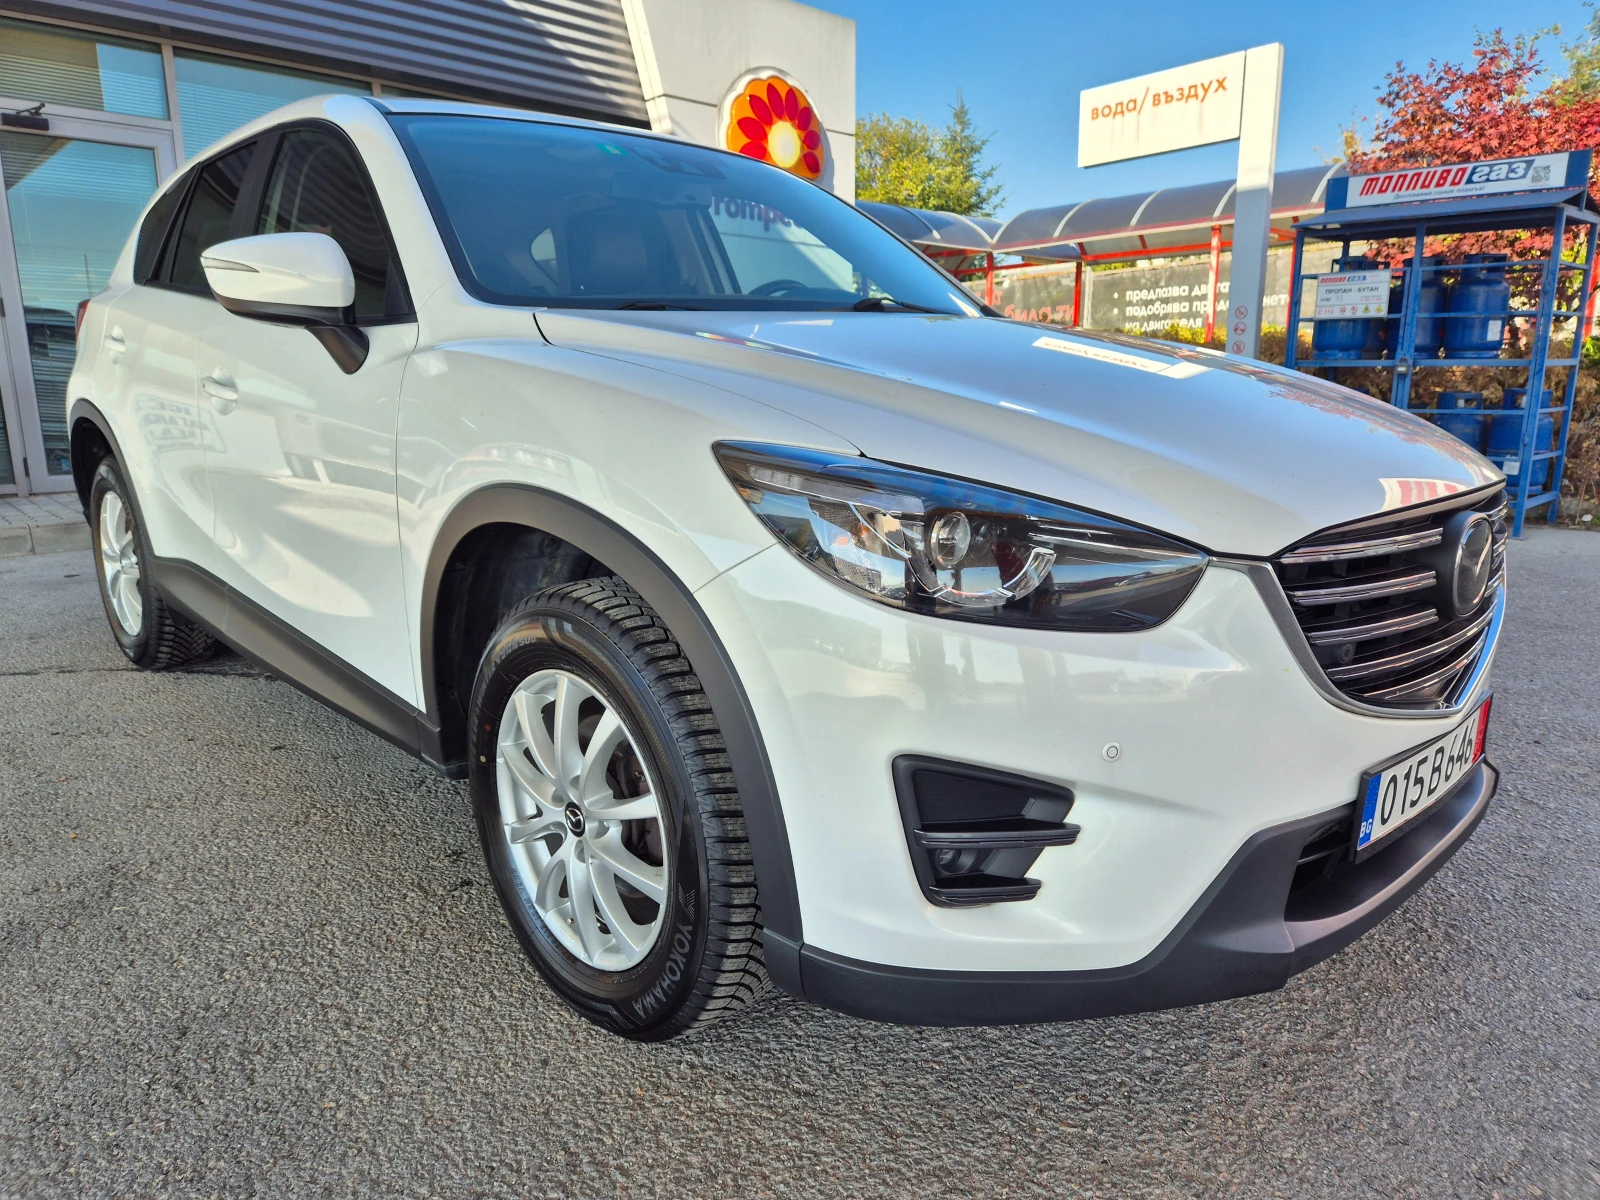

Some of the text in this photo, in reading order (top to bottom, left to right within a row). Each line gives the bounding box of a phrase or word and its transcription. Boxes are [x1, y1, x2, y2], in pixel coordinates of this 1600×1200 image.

[1090, 76, 1228, 121] вода/въздух
[1125, 285, 1189, 304] предпазва
[1125, 301, 1189, 317] подобрява
[1380, 718, 1476, 826] 015B646
[1360, 818, 1373, 838] BG
[632, 921, 693, 1019] YOKOHAMA
